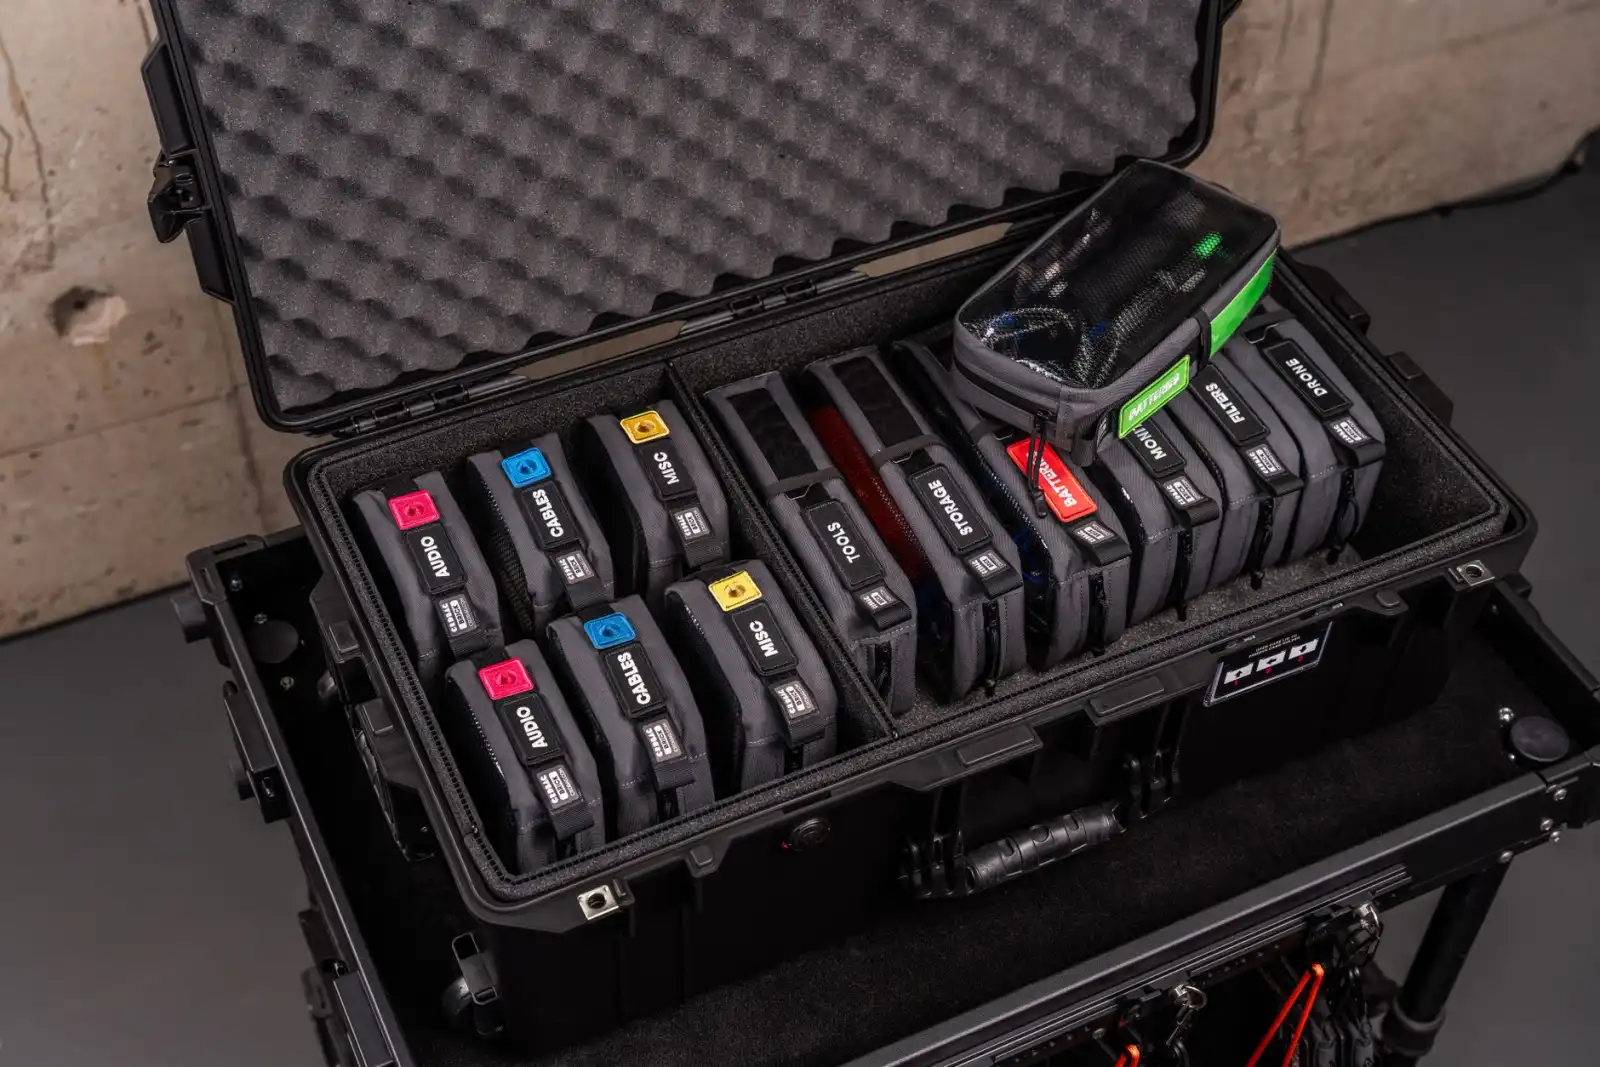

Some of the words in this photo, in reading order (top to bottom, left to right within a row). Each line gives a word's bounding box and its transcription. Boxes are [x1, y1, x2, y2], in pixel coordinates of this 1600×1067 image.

[1285, 357, 1328, 397] DRONE
[1205, 382, 1245, 424] FILTERS
[653, 451, 680, 486] MISC
[532, 488, 564, 538] CABLES
[927, 479, 973, 536] STORAGE
[420, 535, 450, 578] AUDIO
[827, 521, 860, 564] TOOLS
[452, 604, 464, 625] BRICK
[749, 619, 778, 657] MISC
[617, 651, 651, 705] CABLES
[789, 690, 801, 706] BRICK
[516, 706, 548, 748] AUDIO
[658, 730, 669, 749] BRICK
[552, 775, 565, 794] BRICK
